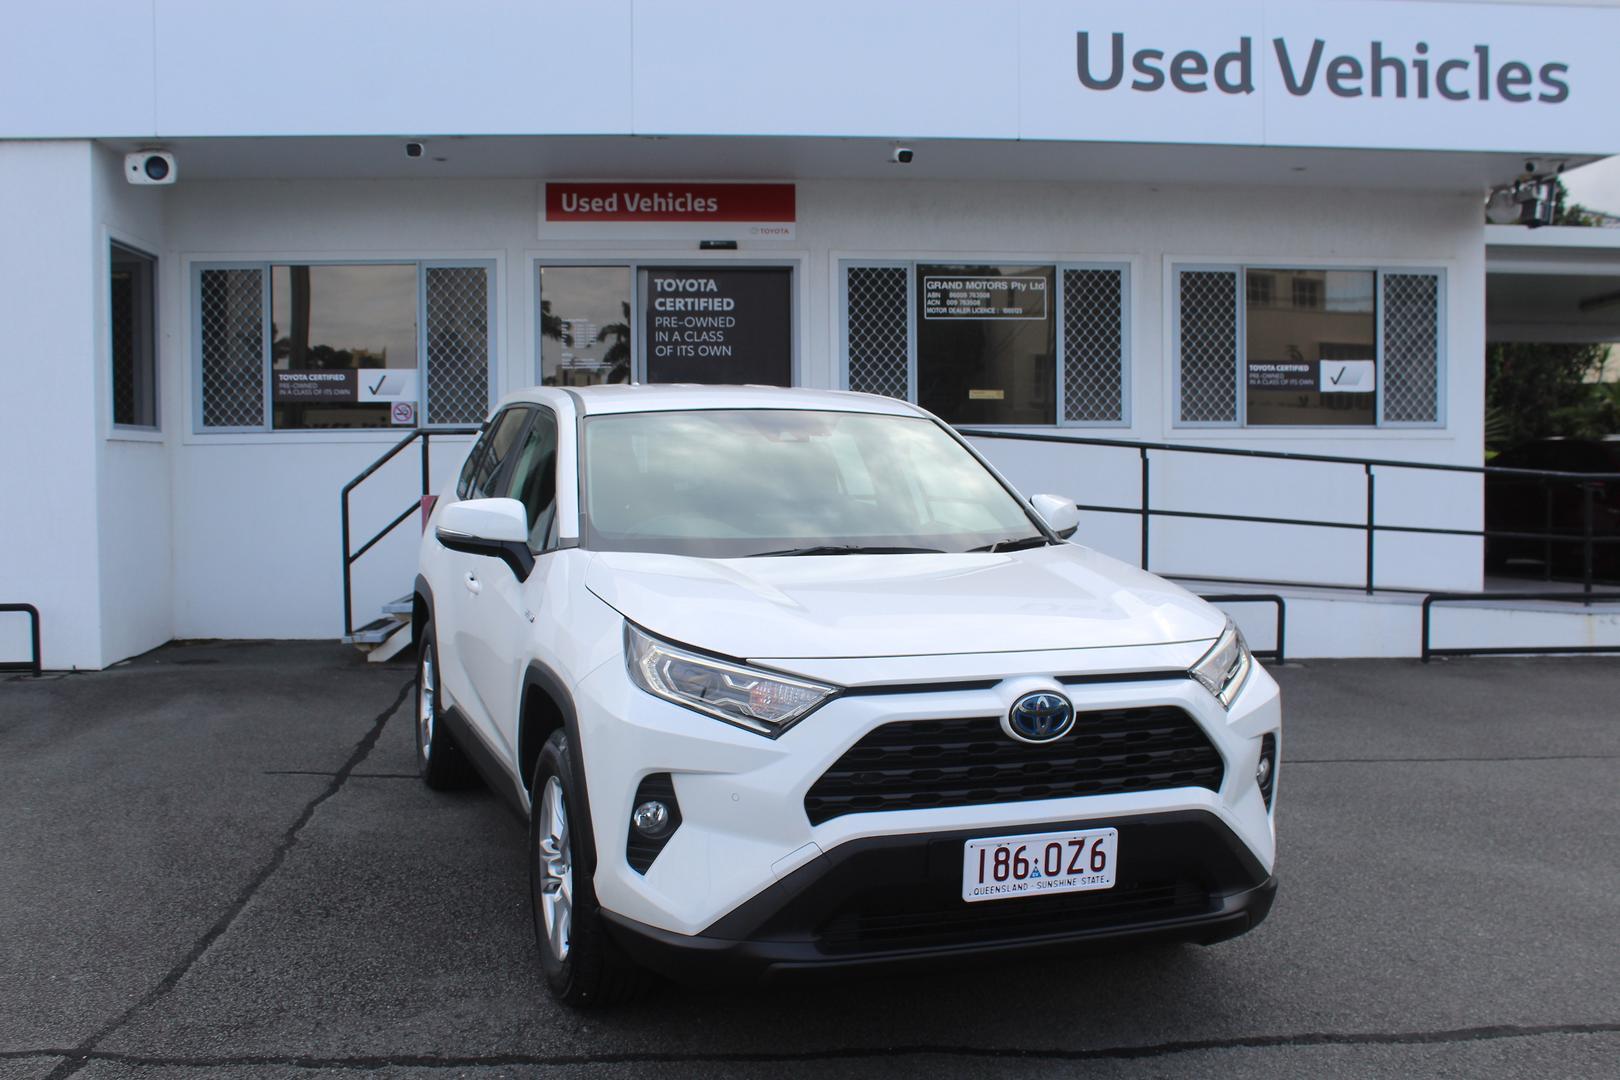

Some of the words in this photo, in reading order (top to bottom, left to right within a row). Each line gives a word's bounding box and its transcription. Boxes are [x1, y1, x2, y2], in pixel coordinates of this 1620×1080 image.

[1076, 31, 1255, 96] Used
[1272, 36, 1571, 105] Vehicles
[561, 192, 618, 213] Used
[624, 192, 718, 213] Vehicles
[760, 227, 790, 235] TOYOTA
[654, 278, 718, 293] TOYOTA
[926, 281, 963, 290] GRAND
[966, 281, 1008, 290] MOTORS
[1011, 281, 1027, 292] Pty
[1030, 281, 1045, 290] Ltd
[654, 297, 735, 312] CERTIFIED
[655, 316, 736, 328] PRE-OWNED
[655, 331, 669, 342] IN
[672, 331, 681, 342] A
[684, 331, 724, 342] CLASS
[655, 345, 674, 357] OF
[677, 345, 694, 357] ITS
[697, 345, 732, 357] OWN
[1249, 364, 1275, 372] TOYOTA
[1276, 364, 1310, 372] CERTIFIED
[978, 845, 1030, 884] 186
[973, 882, 1029, 896] QUEENSLAND
[1036, 878, 1077, 889] SUNSHINE
[1081, 875, 1105, 885] STATE
